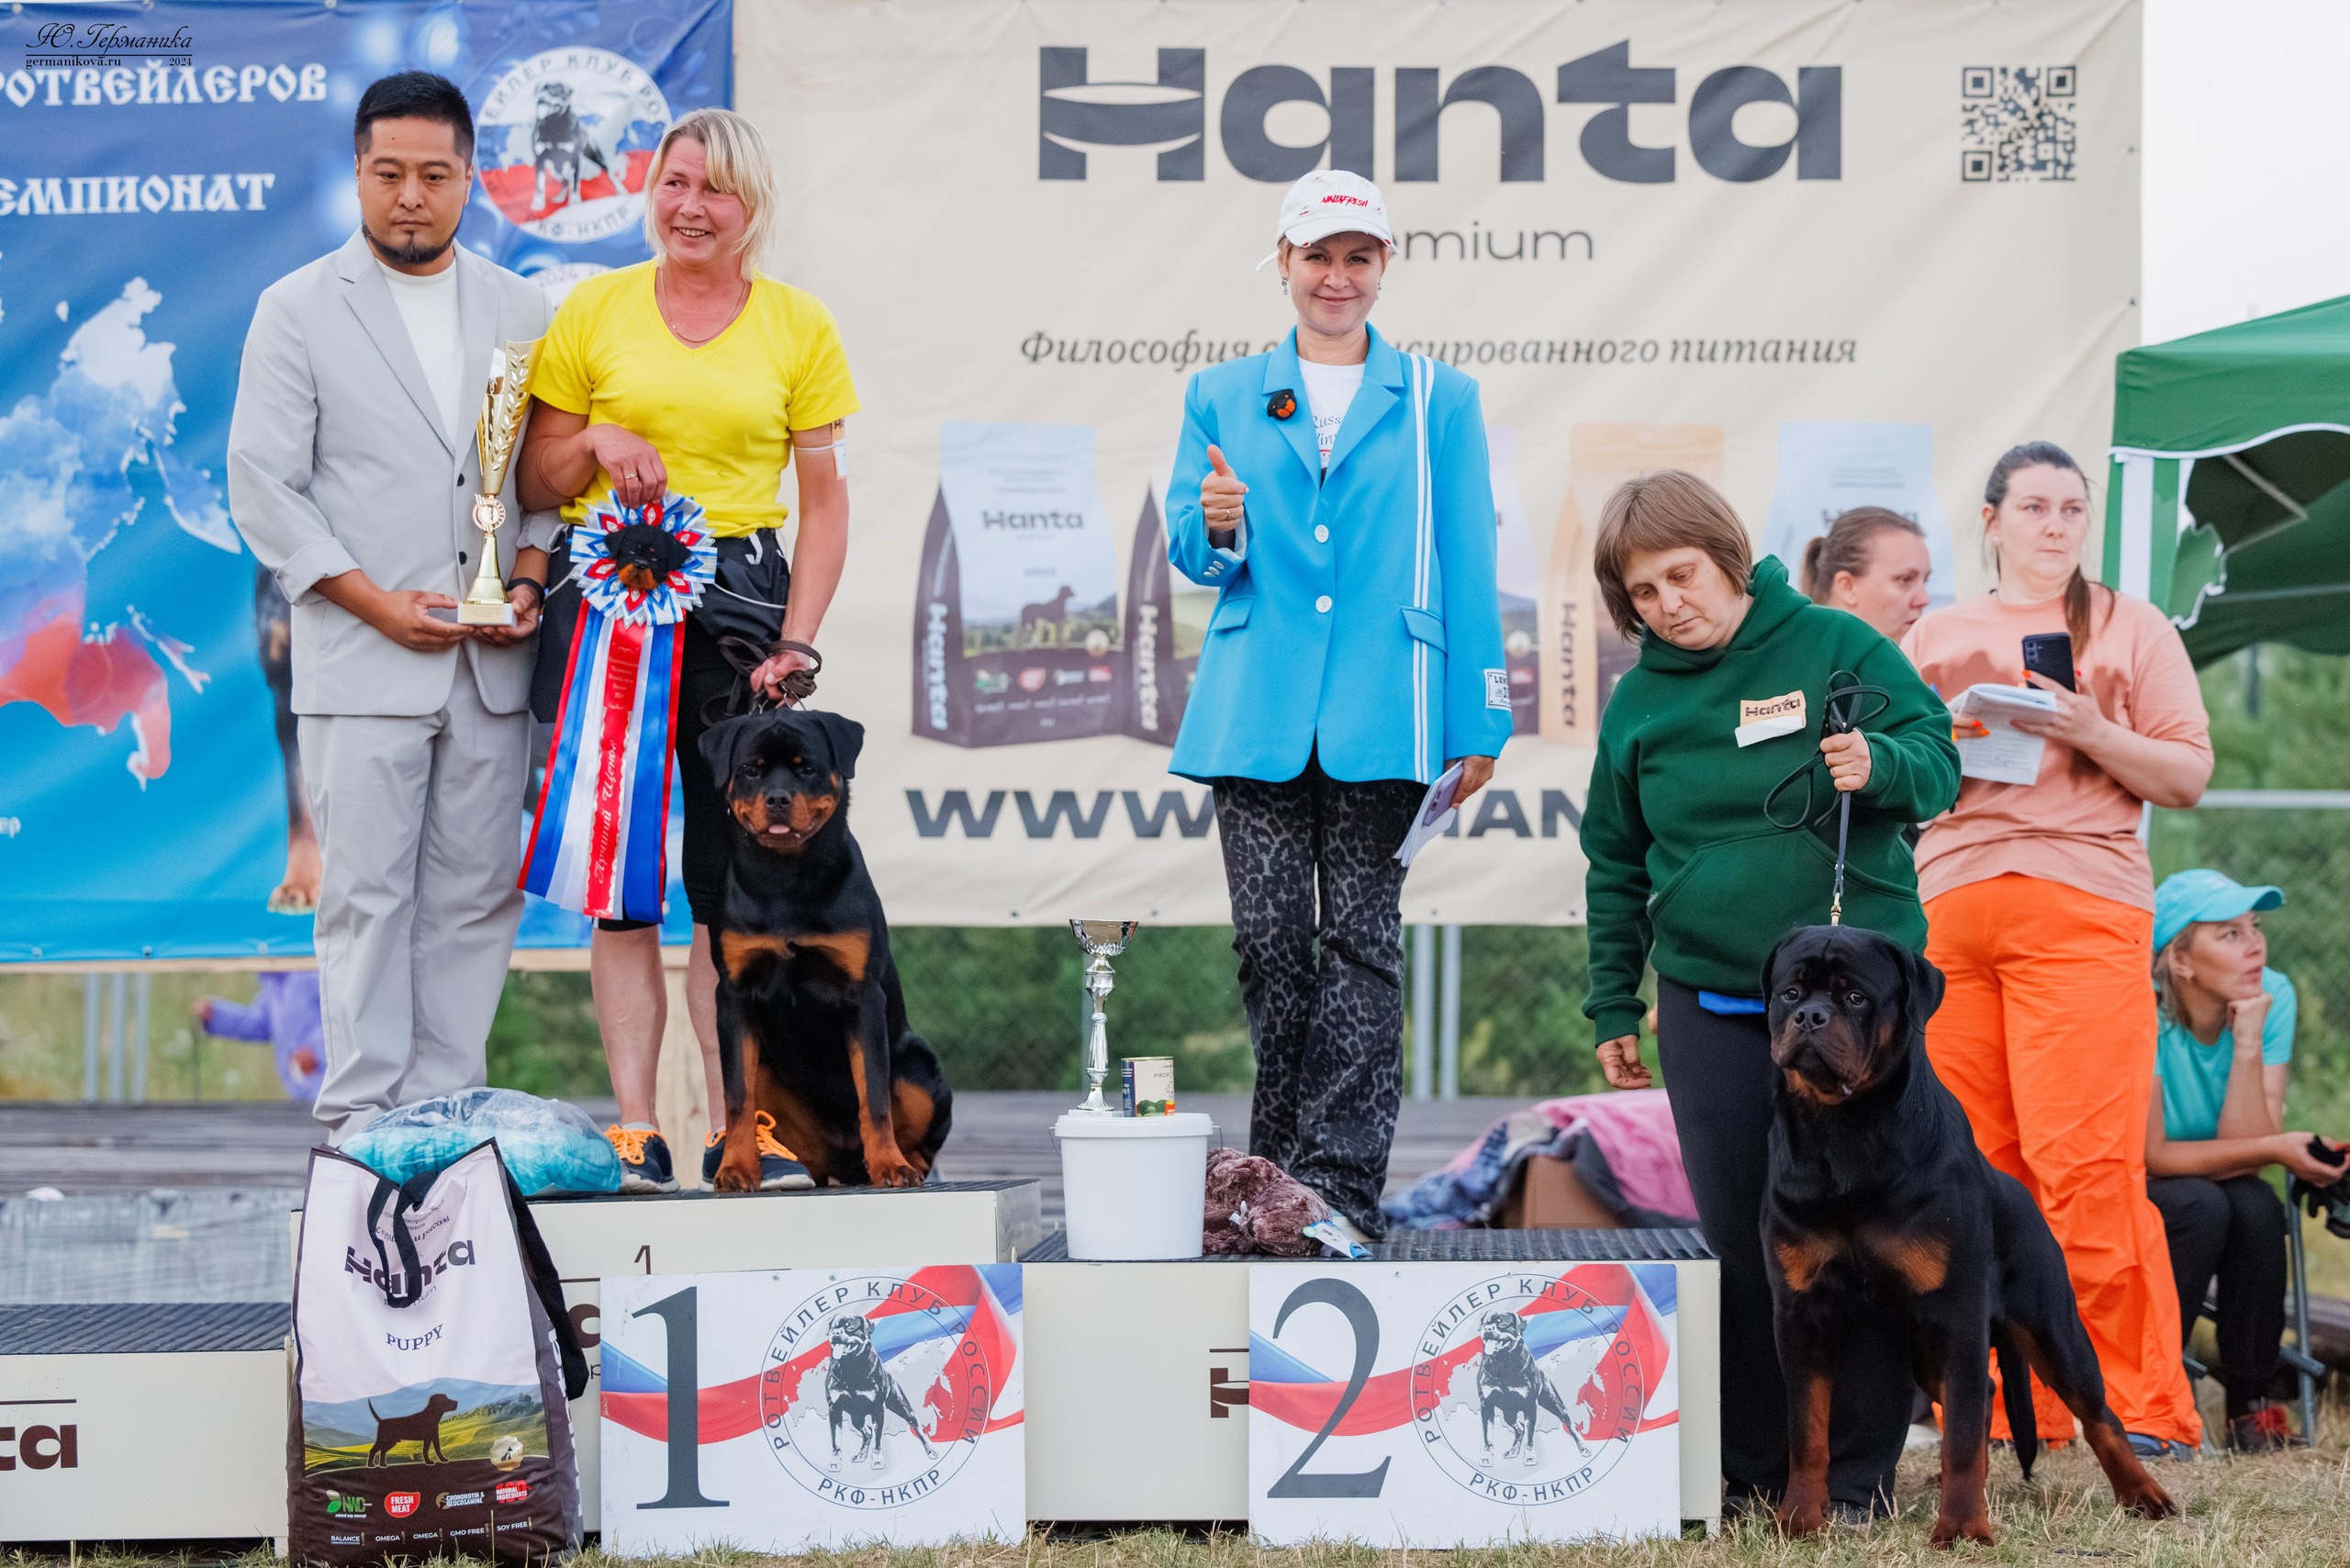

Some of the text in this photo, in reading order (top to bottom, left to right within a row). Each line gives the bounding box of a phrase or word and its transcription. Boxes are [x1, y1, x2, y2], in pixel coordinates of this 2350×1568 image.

[0, 59, 328, 108] ОТВЕЙЛЕРОВ
[566, 53, 632, 83] КЛУБ
[1039, 39, 1842, 184] Hanta
[0, 173, 276, 217] ЕМПИОНАТ
[1393, 220, 1595, 261] mium
[1021, 329, 1249, 373] Философия
[1669, 339, 1859, 364] питания
[1313, 416, 1346, 429] Russ
[982, 510, 1085, 531] Hanta
[1561, 601, 1577, 727] Hanta
[1745, 698, 1801, 717] Hanta
[633, 1244, 652, 1275] 1
[386, 1324, 444, 1351] PUPPY
[764, 1281, 988, 1450] РОТВЕЙЛЕР КЛУБ РОССИИ
[1415, 1278, 1641, 1445] РОТВЕЙЛЕР КЛУБ РОССИИ
[631, 1285, 731, 1510] 1
[1267, 1277, 1393, 1499] 2
[390, 1495, 414, 1505] FRESH
[496, 1486, 518, 1495] NATURAL
[497, 1490, 528, 1501] INGREDIENTS
[817, 1469, 942, 1506] РКФ-НКПР
[1469, 1466, 1595, 1502] РКФ-НКПР
[391, 1505, 410, 1513] MEAT
[446, 1497, 483, 1507] GLUCOSAMINE
[511, 1521, 528, 1529] FREE
